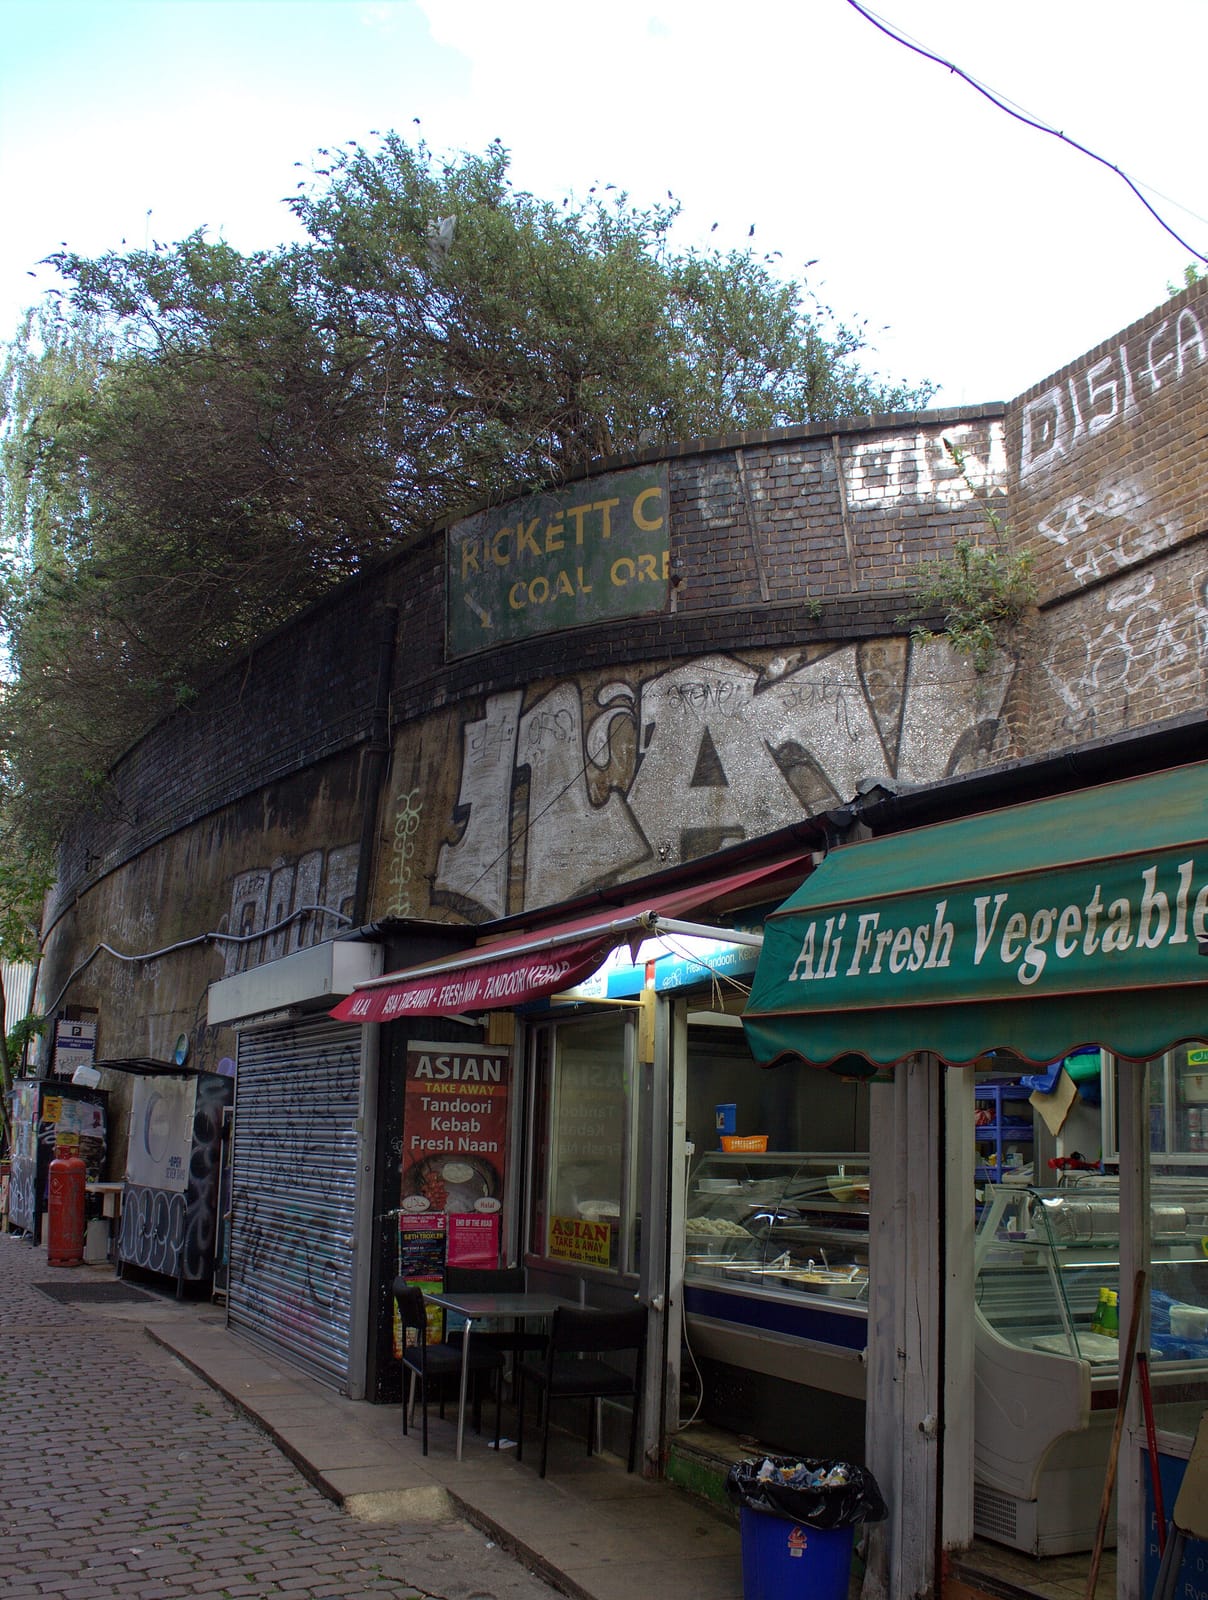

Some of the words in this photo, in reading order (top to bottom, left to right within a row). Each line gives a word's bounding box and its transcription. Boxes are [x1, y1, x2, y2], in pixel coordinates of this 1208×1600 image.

[461, 498, 619, 583] RICKETT
[632, 488, 663, 531] C
[509, 567, 593, 610] COAL
[789, 913, 846, 981] Ali
[846, 901, 954, 976] Fresh
[414, 1055, 500, 1082] ASIAN
[425, 1083, 456, 1094] TAKE
[459, 1084, 495, 1095] AWAY
[420, 1097, 492, 1114] Tandoori
[431, 1116, 481, 1133] Kebab
[411, 1135, 454, 1151] Fresh
[458, 1138, 498, 1152] Naan
[552, 1219, 608, 1242] ASIAN
[555, 1236, 574, 1248] TAKE
[583, 1241, 603, 1253] AWAY
